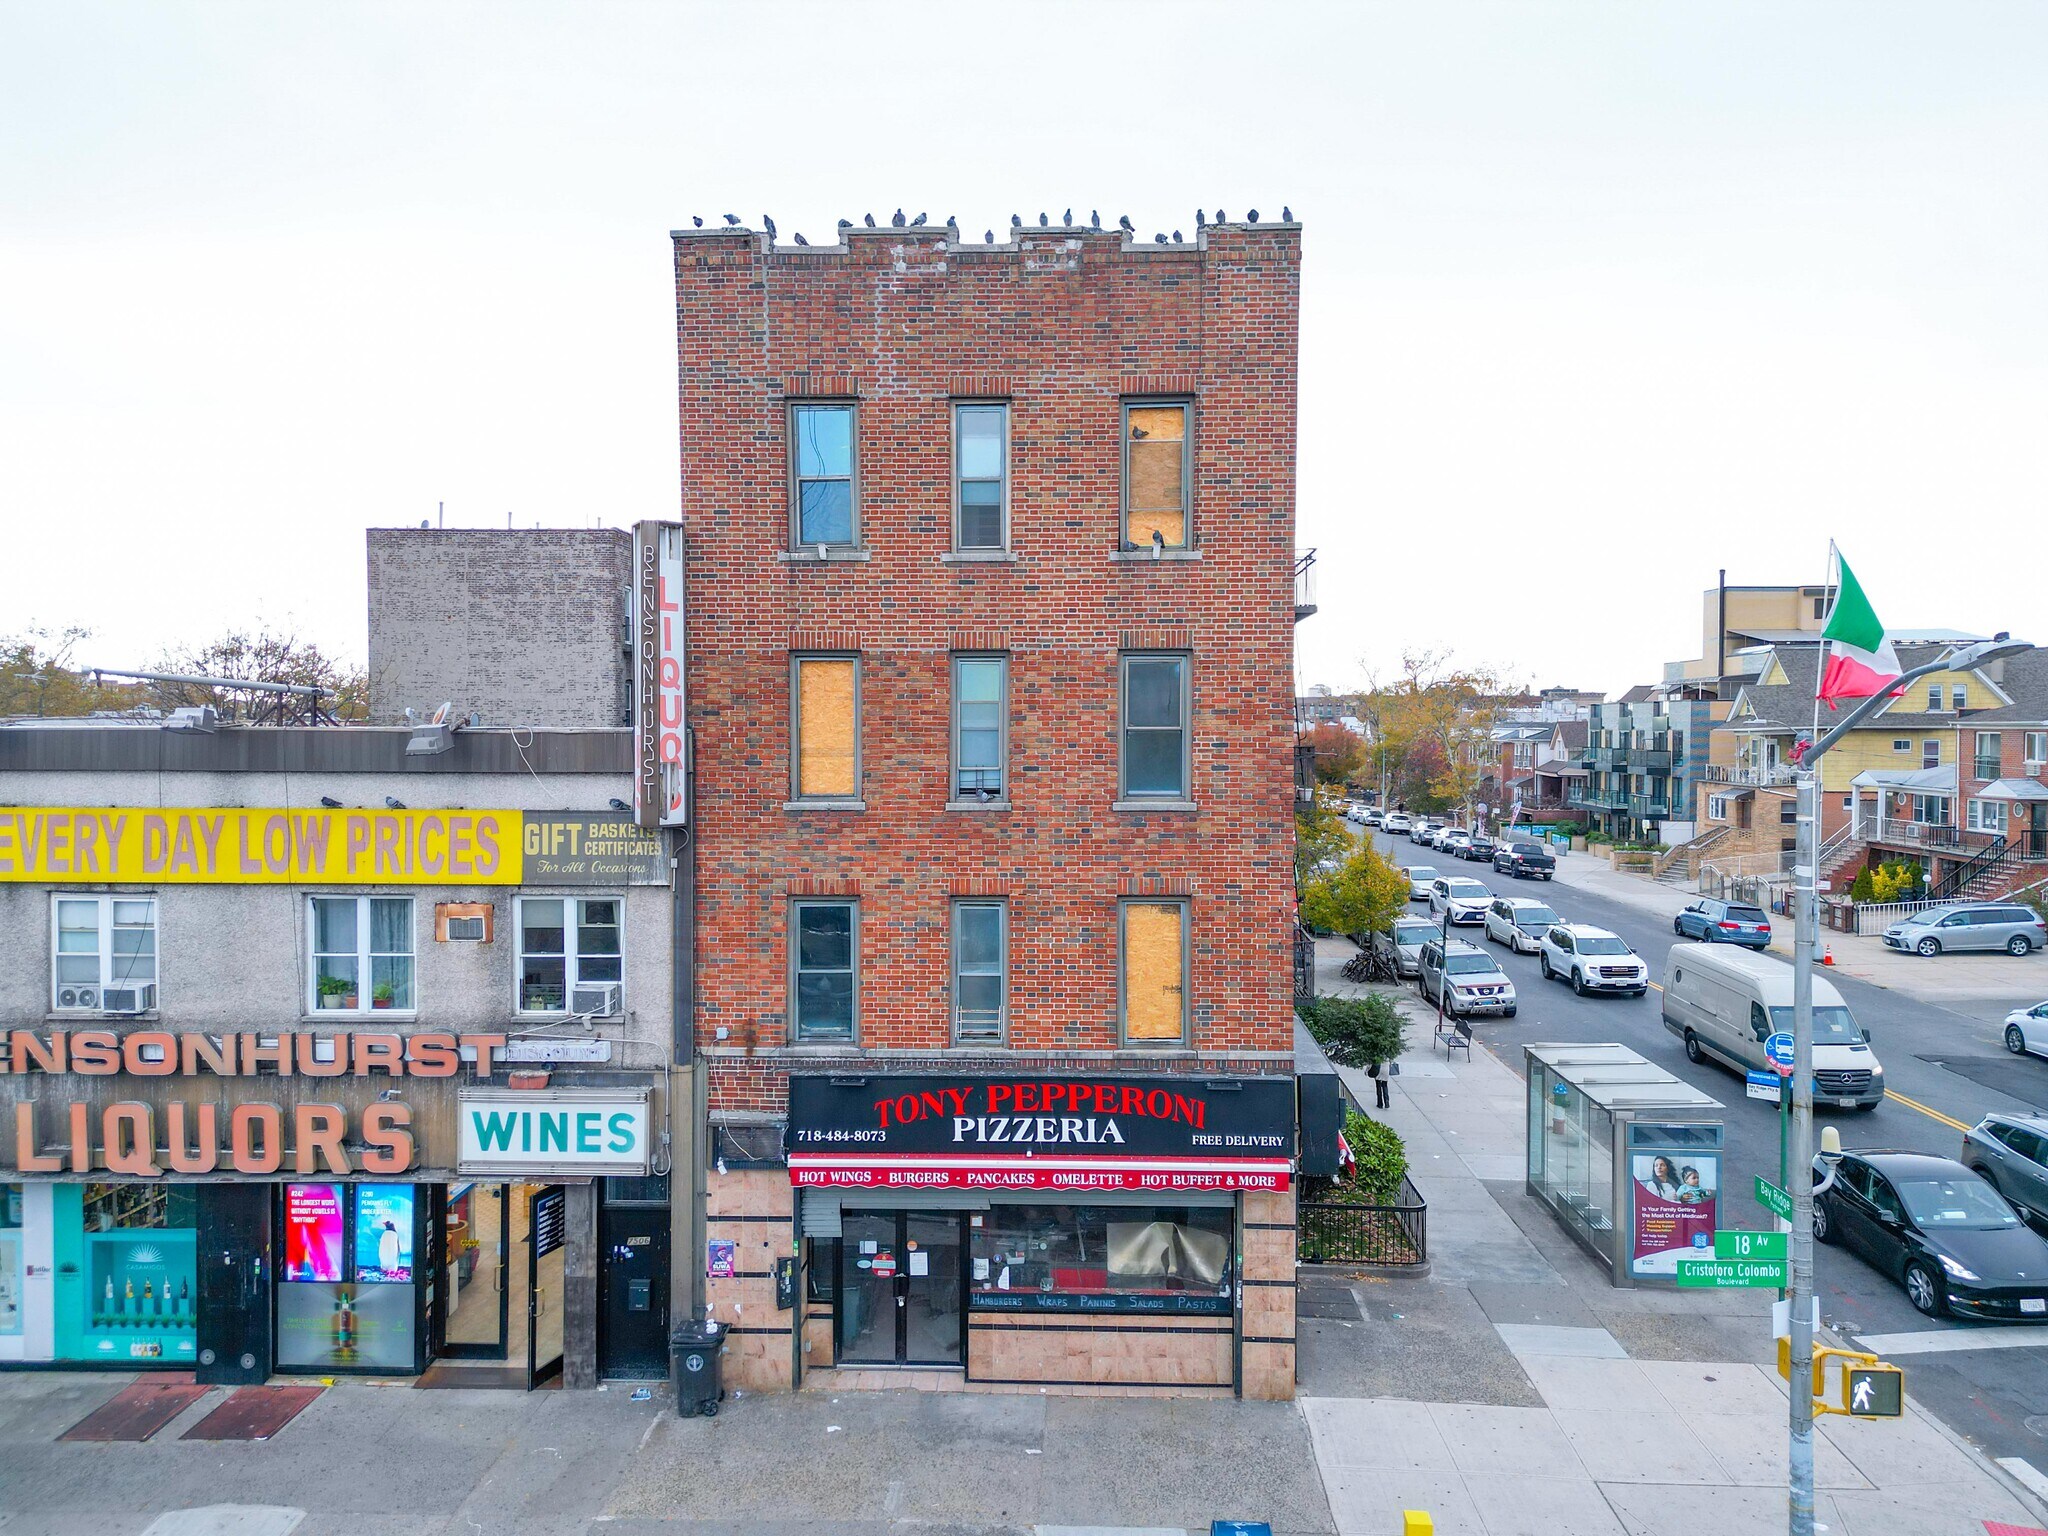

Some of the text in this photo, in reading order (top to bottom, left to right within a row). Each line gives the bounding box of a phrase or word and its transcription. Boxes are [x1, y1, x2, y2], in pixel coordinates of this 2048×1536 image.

[0, 814, 500, 876] EVERY DAY LOW PRICES
[524, 823, 582, 856] GIFT
[584, 841, 662, 856] CERTIFICATES
[536, 860, 649, 874] For All Occasions
[874, 1083, 1206, 1129] TONY PEPPERONI
[472, 1111, 636, 1153] WINES
[798, 1130, 886, 1142] 718-484-8073
[952, 1117, 1126, 1144] PIZZERIA
[16, 1100, 413, 1177] LIQUORS
[1192, 1135, 1285, 1147] FREE DELIVERY
[799, 1171, 872, 1182] HOT WINGS
[889, 1173, 949, 1183] BURGERS
[967, 1173, 1035, 1184] PANCAKES
[1053, 1174, 1124, 1185] OMELETTE
[1141, 1175, 1276, 1187] HOT BUFFET & MORE
[1761, 1181, 1791, 1212] Bay Ridge
[628, 1236, 650, 1245] 7506
[1734, 1234, 1769, 1255] 18 Av
[1685, 1263, 1781, 1277] Cristoforo Colombo
[972, 1293, 1023, 1306] HAMBURGERS
[1036, 1294, 1068, 1306] WRAPS
